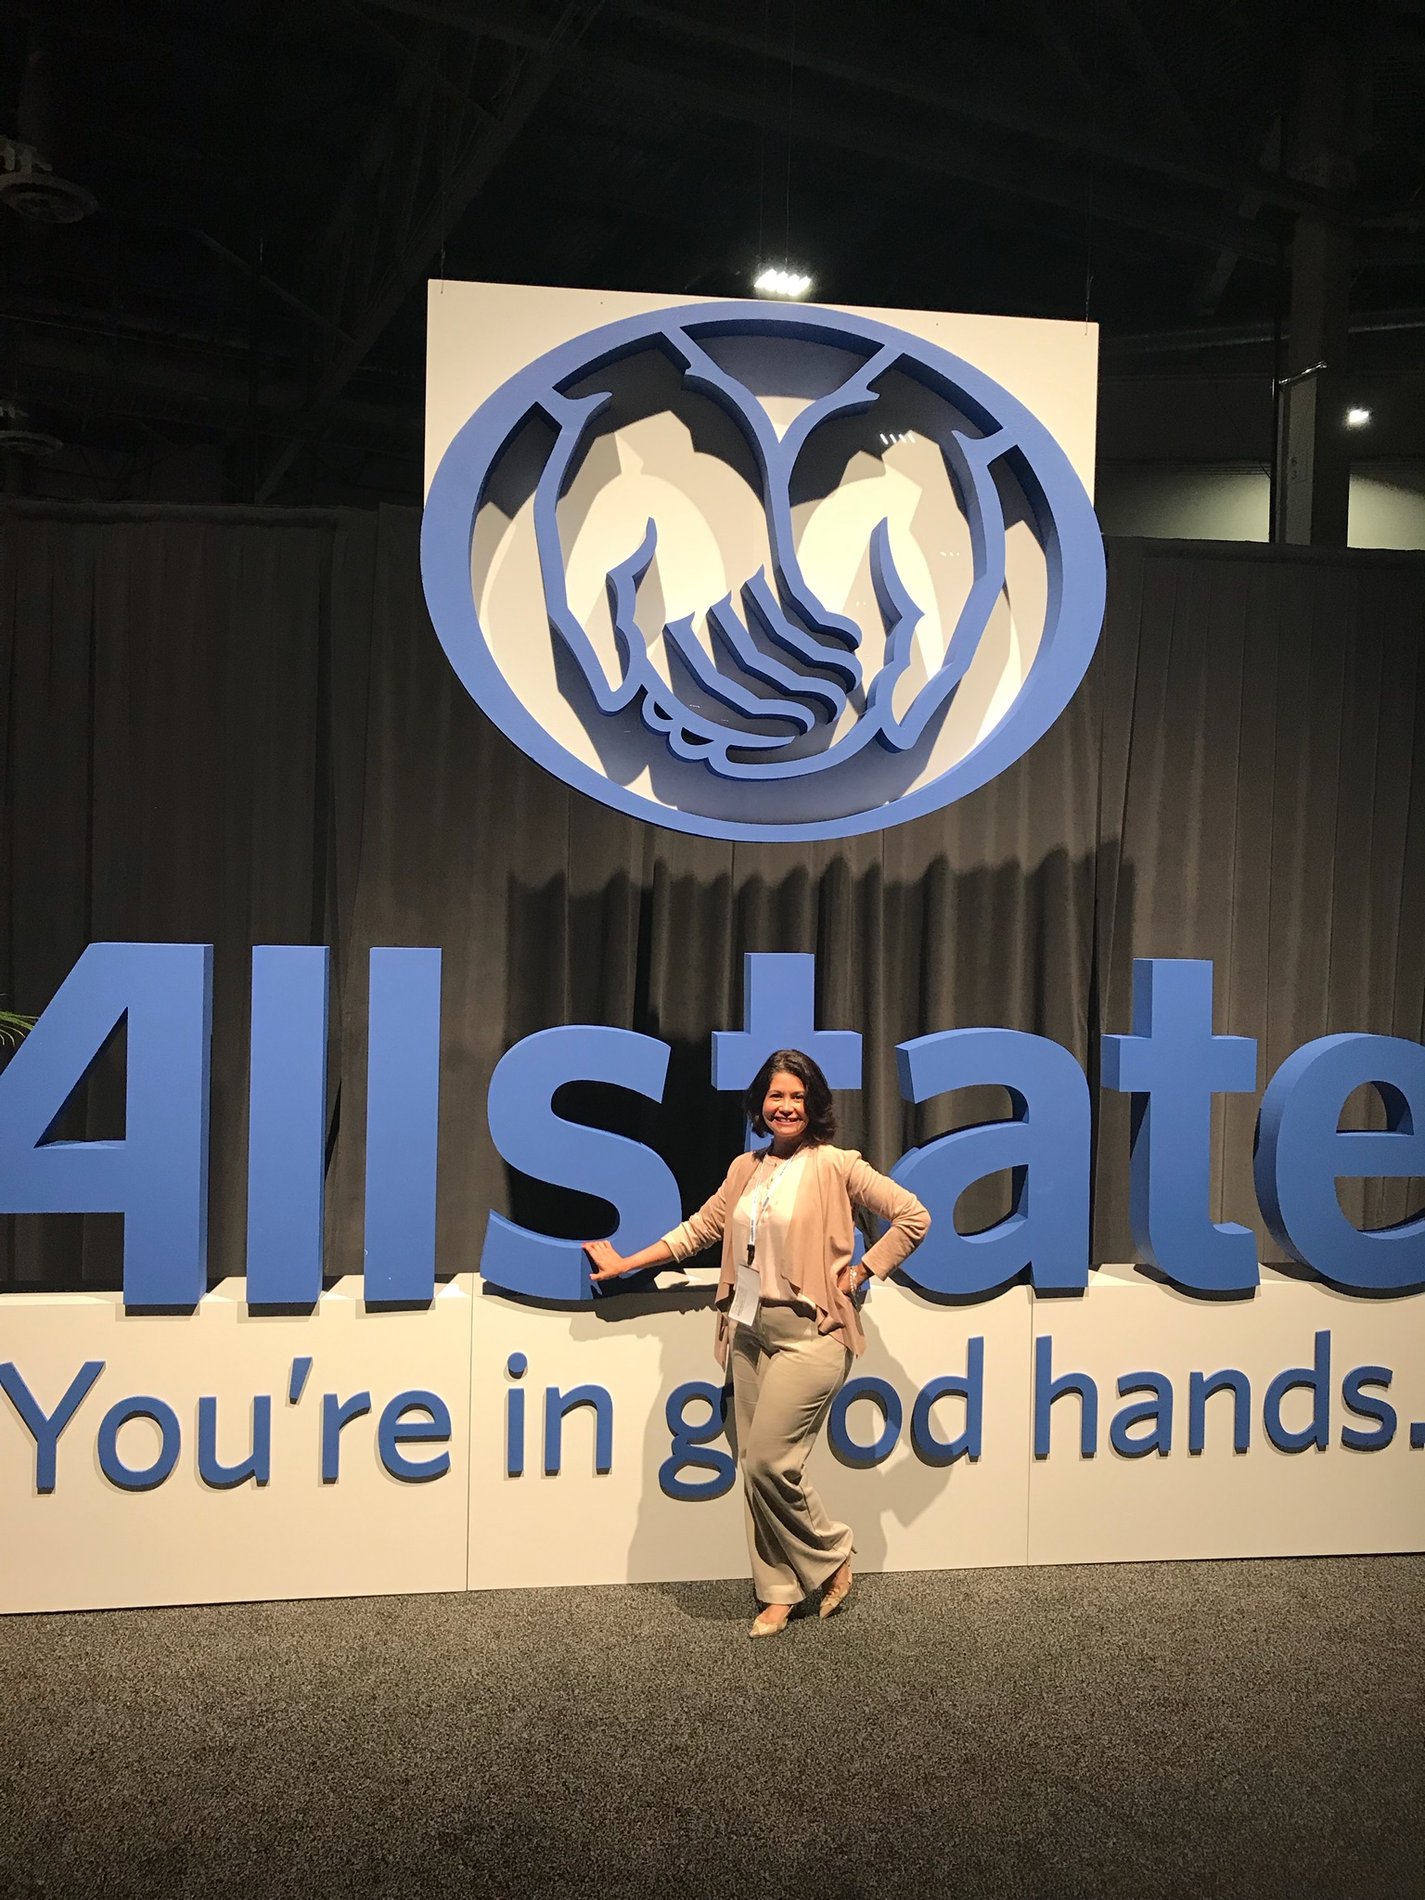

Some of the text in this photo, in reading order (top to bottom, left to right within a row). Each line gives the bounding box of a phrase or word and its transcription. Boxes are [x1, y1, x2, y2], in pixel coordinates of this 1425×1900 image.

[0, 1329, 1425, 1502] You're in god hands.
